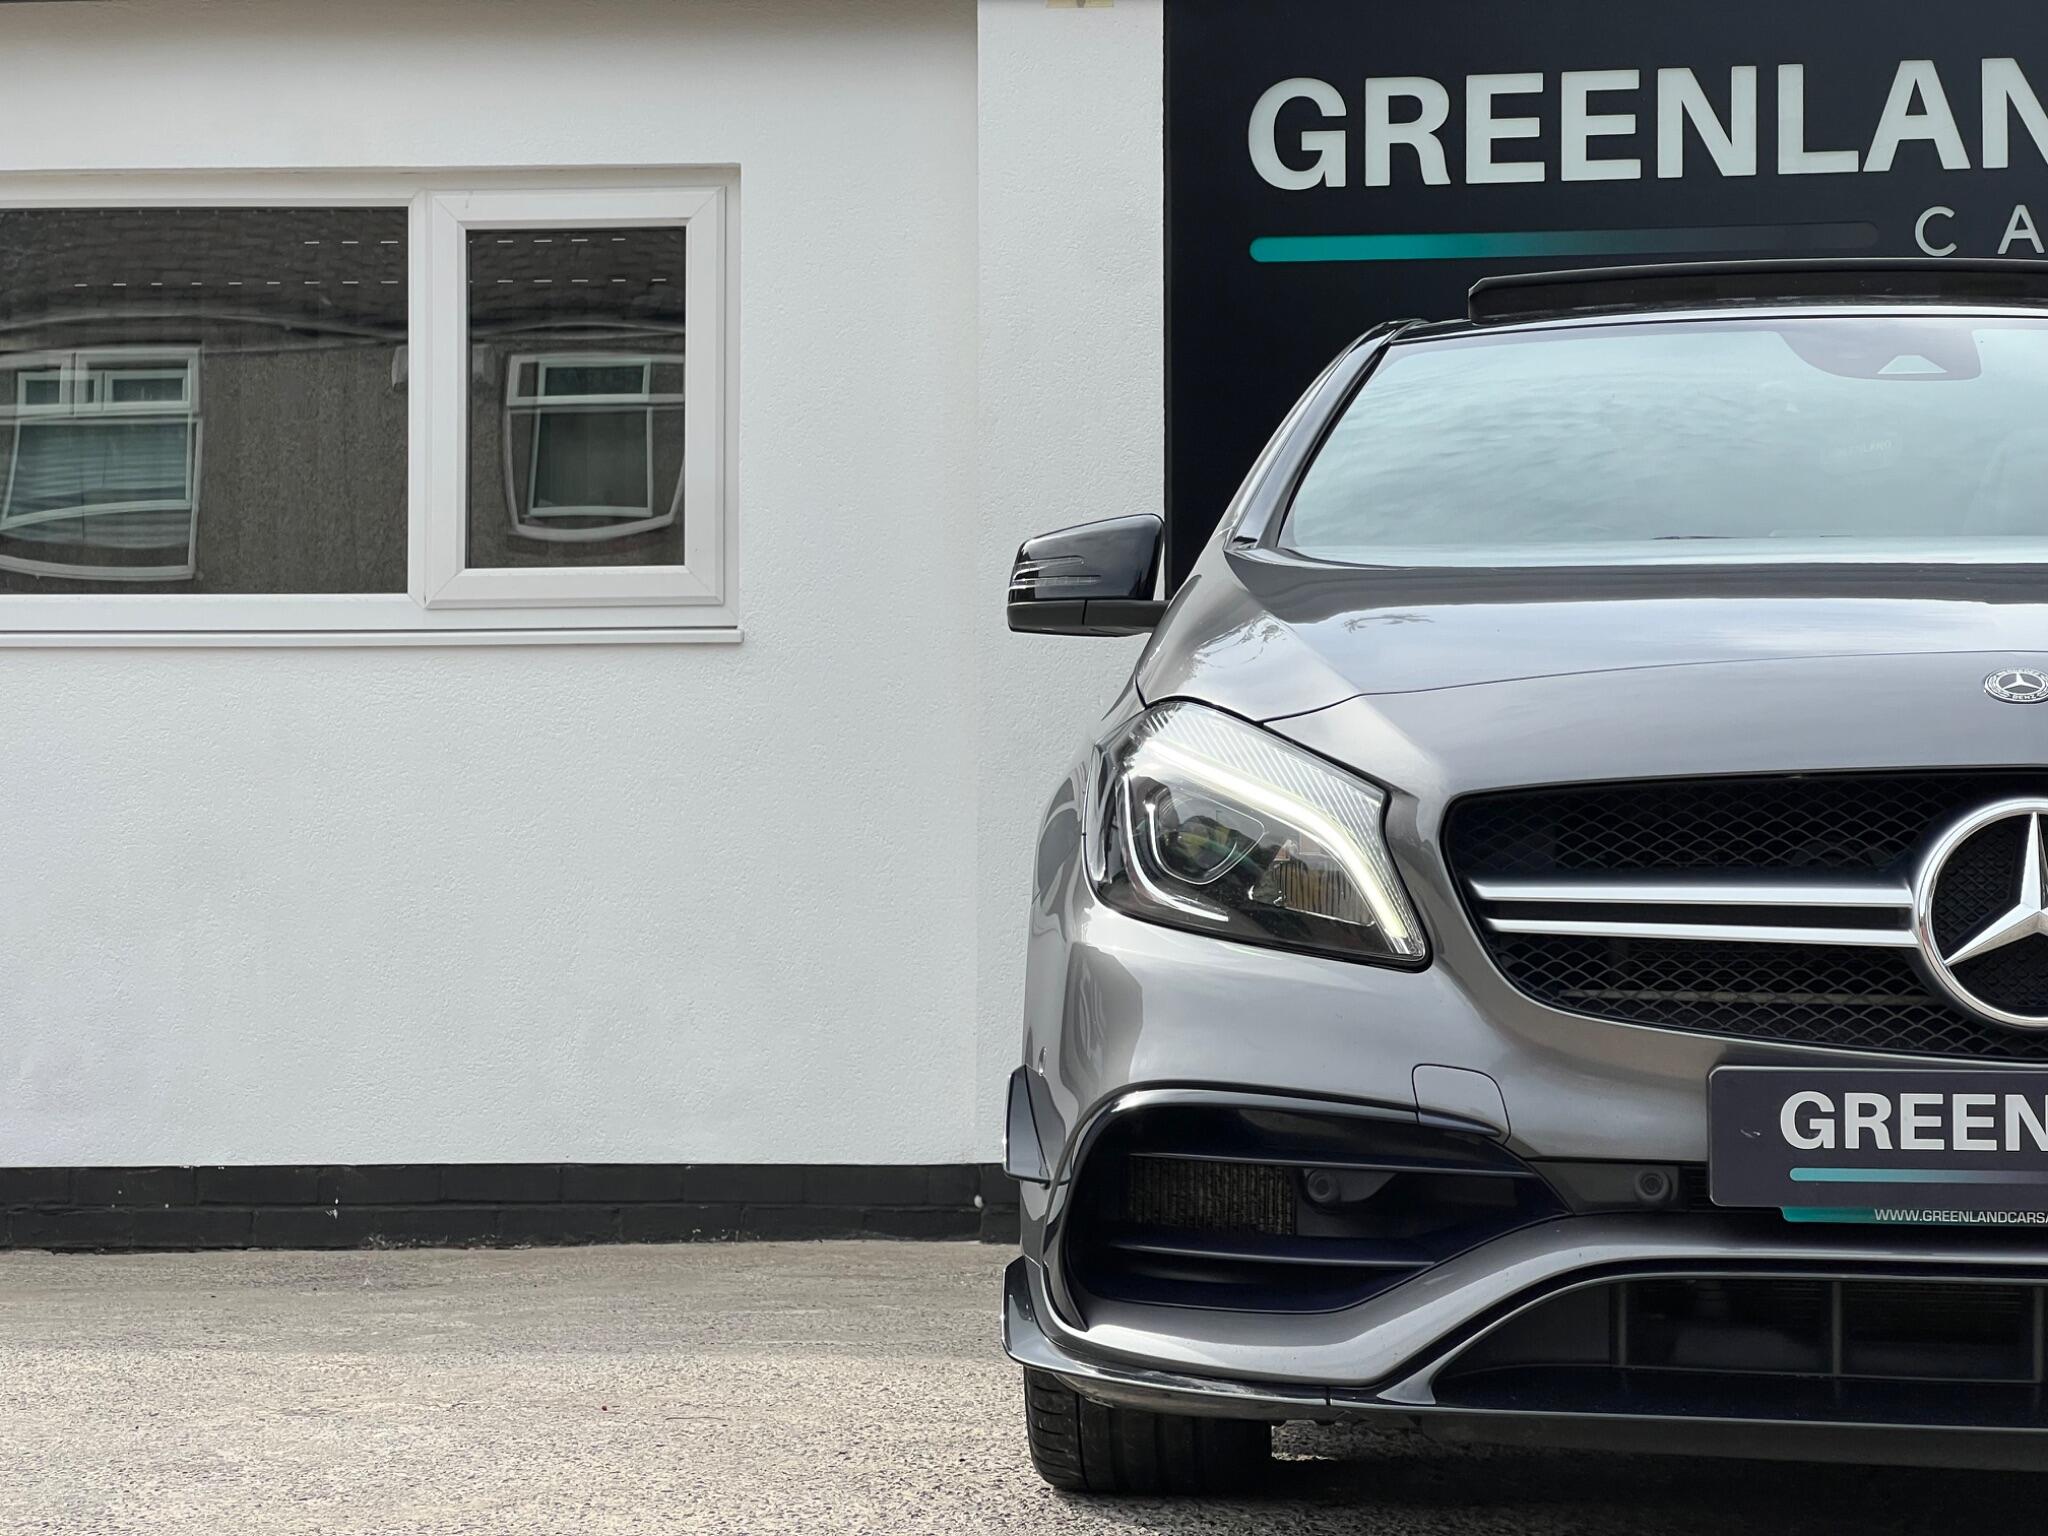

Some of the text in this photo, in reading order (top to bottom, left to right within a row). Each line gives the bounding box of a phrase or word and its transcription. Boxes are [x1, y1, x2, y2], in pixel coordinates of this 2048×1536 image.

[1248, 58, 2048, 190] GREENLAN
[1915, 205, 2046, 257] CA
[1780, 1091, 2048, 1151] GREEN
[1874, 1208, 2048, 1224] WWW.GREENLANDCARS
